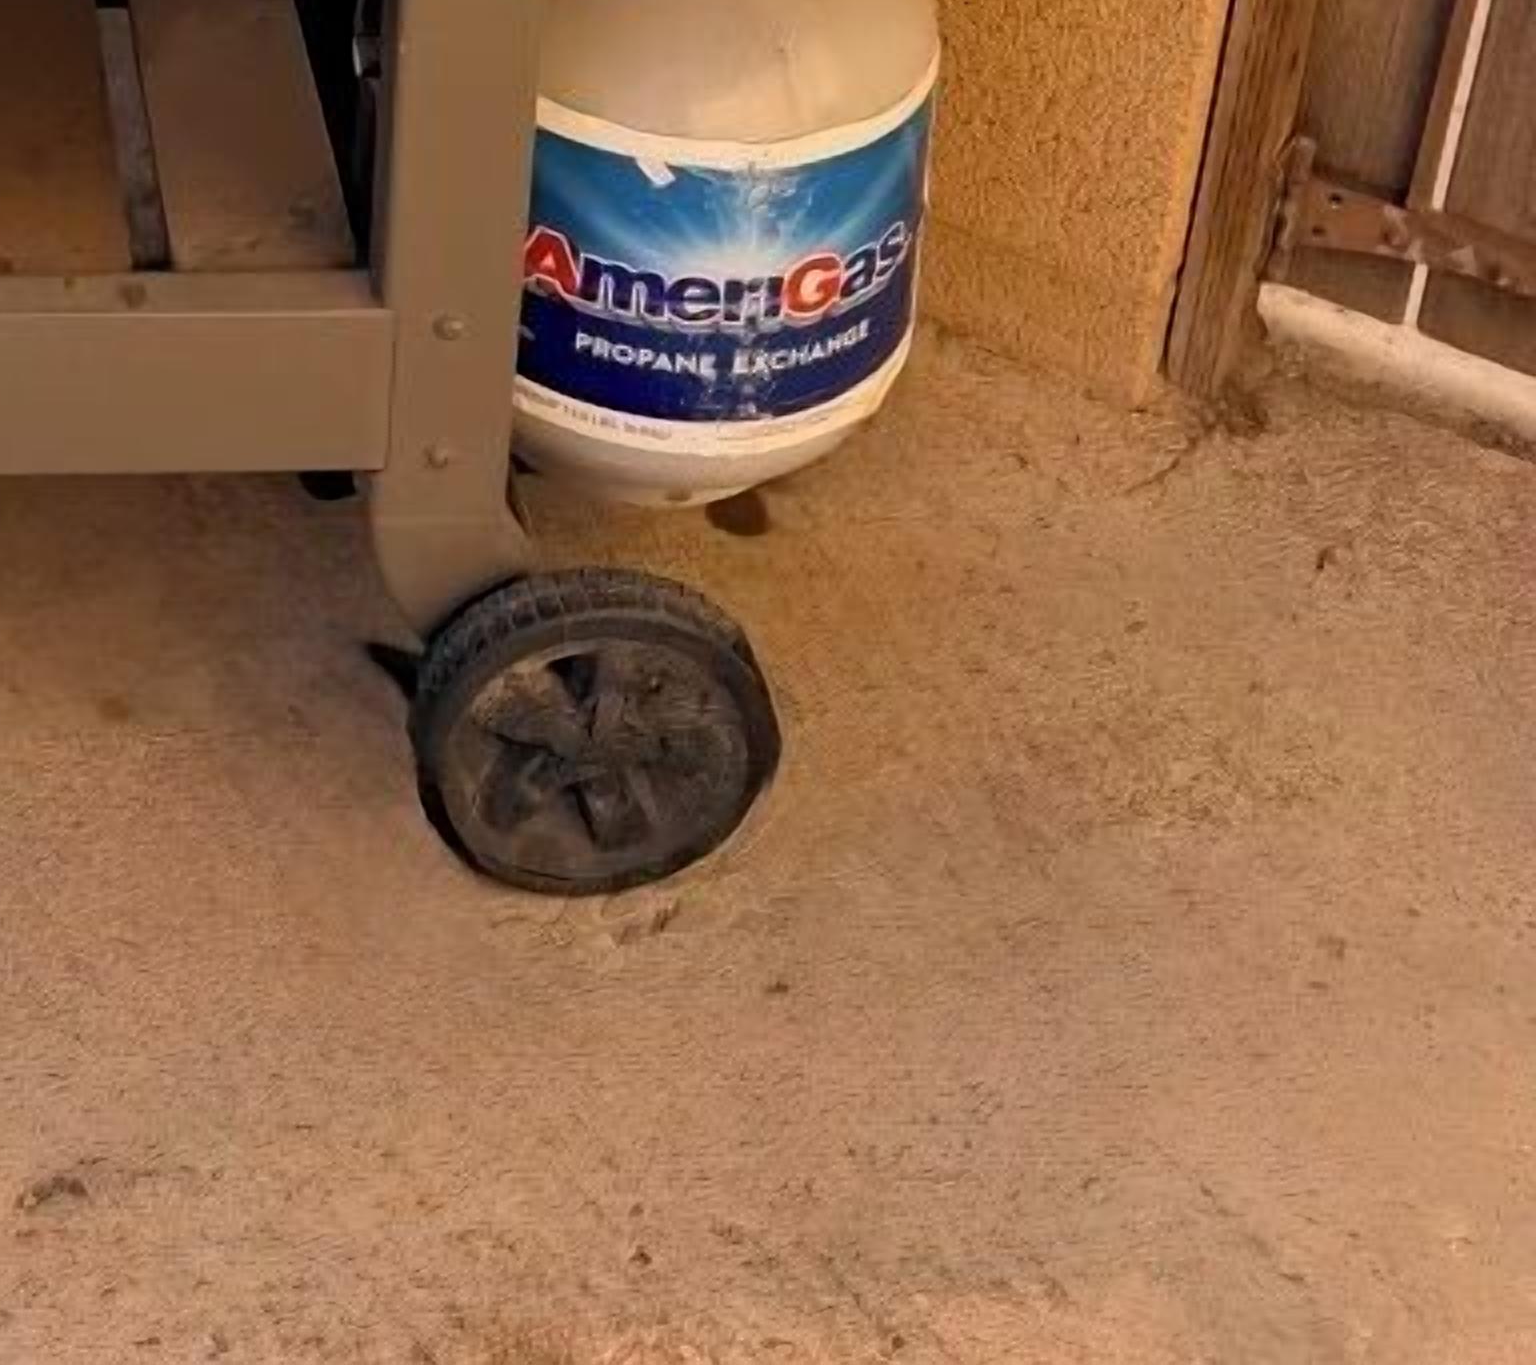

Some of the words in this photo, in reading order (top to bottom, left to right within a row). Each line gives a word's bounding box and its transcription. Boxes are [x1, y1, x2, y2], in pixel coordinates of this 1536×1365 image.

[522, 221, 908, 331] AmeriGas
[574, 330, 718, 377] PROPANE
[731, 319, 869, 376] EXCHANGE
